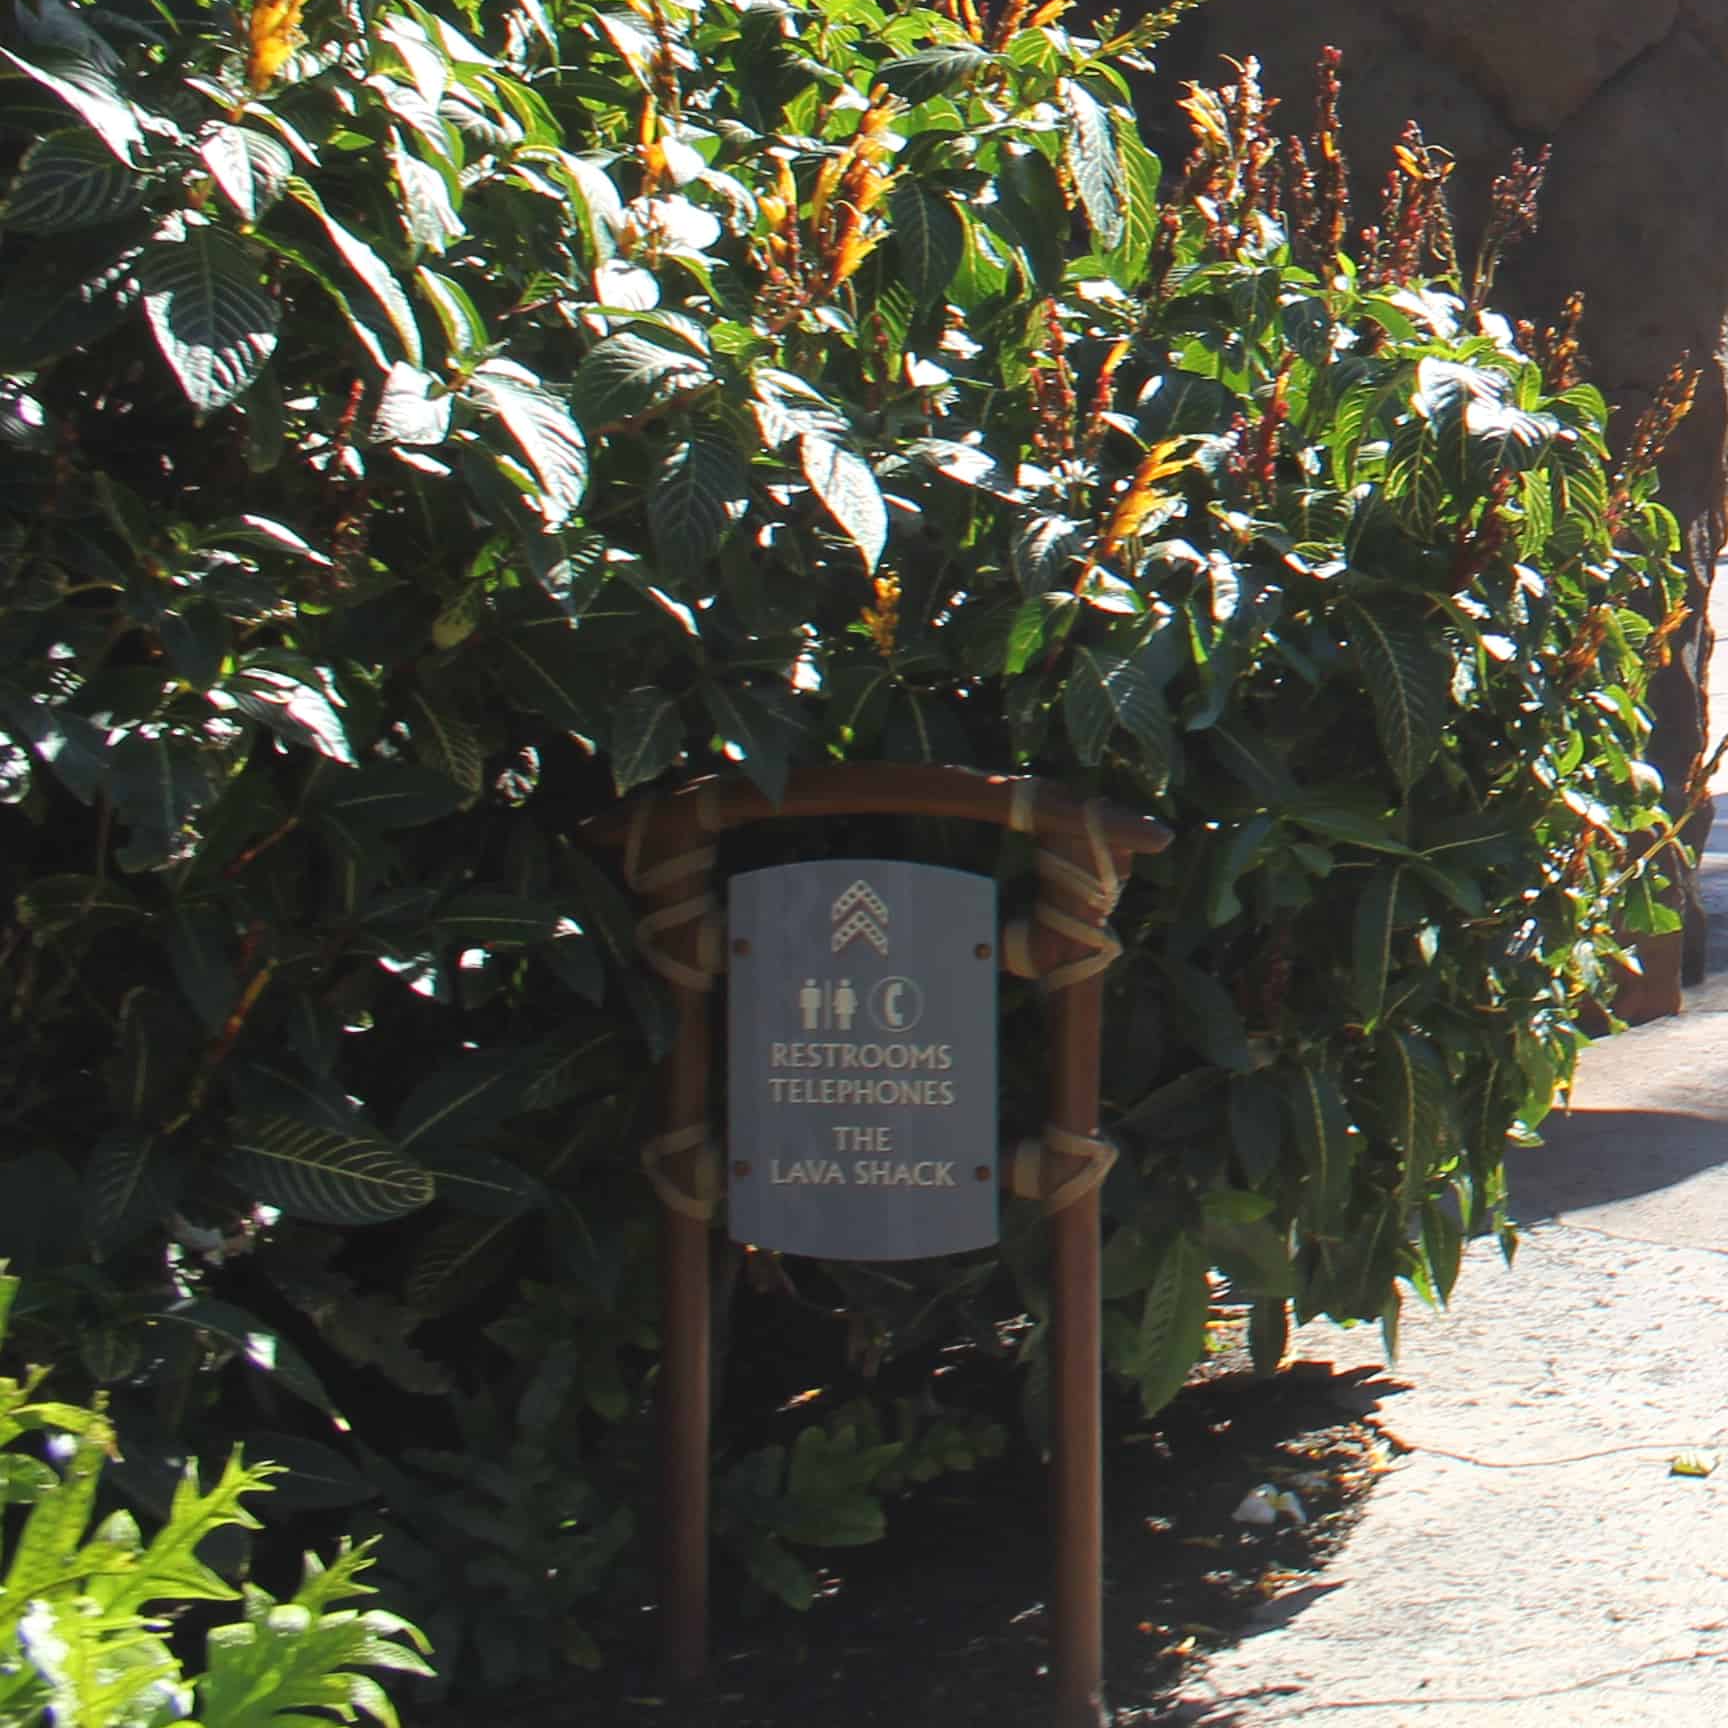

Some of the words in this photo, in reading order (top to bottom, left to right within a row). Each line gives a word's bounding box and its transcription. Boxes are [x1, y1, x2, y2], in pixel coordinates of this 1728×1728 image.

[770, 1043, 952, 1070] RESTROOMS
[768, 1079, 955, 1106] TELEPHONES
[831, 1127, 893, 1152] THE
[770, 1160, 846, 1185] LAVA
[854, 1161, 957, 1187] SHACK
